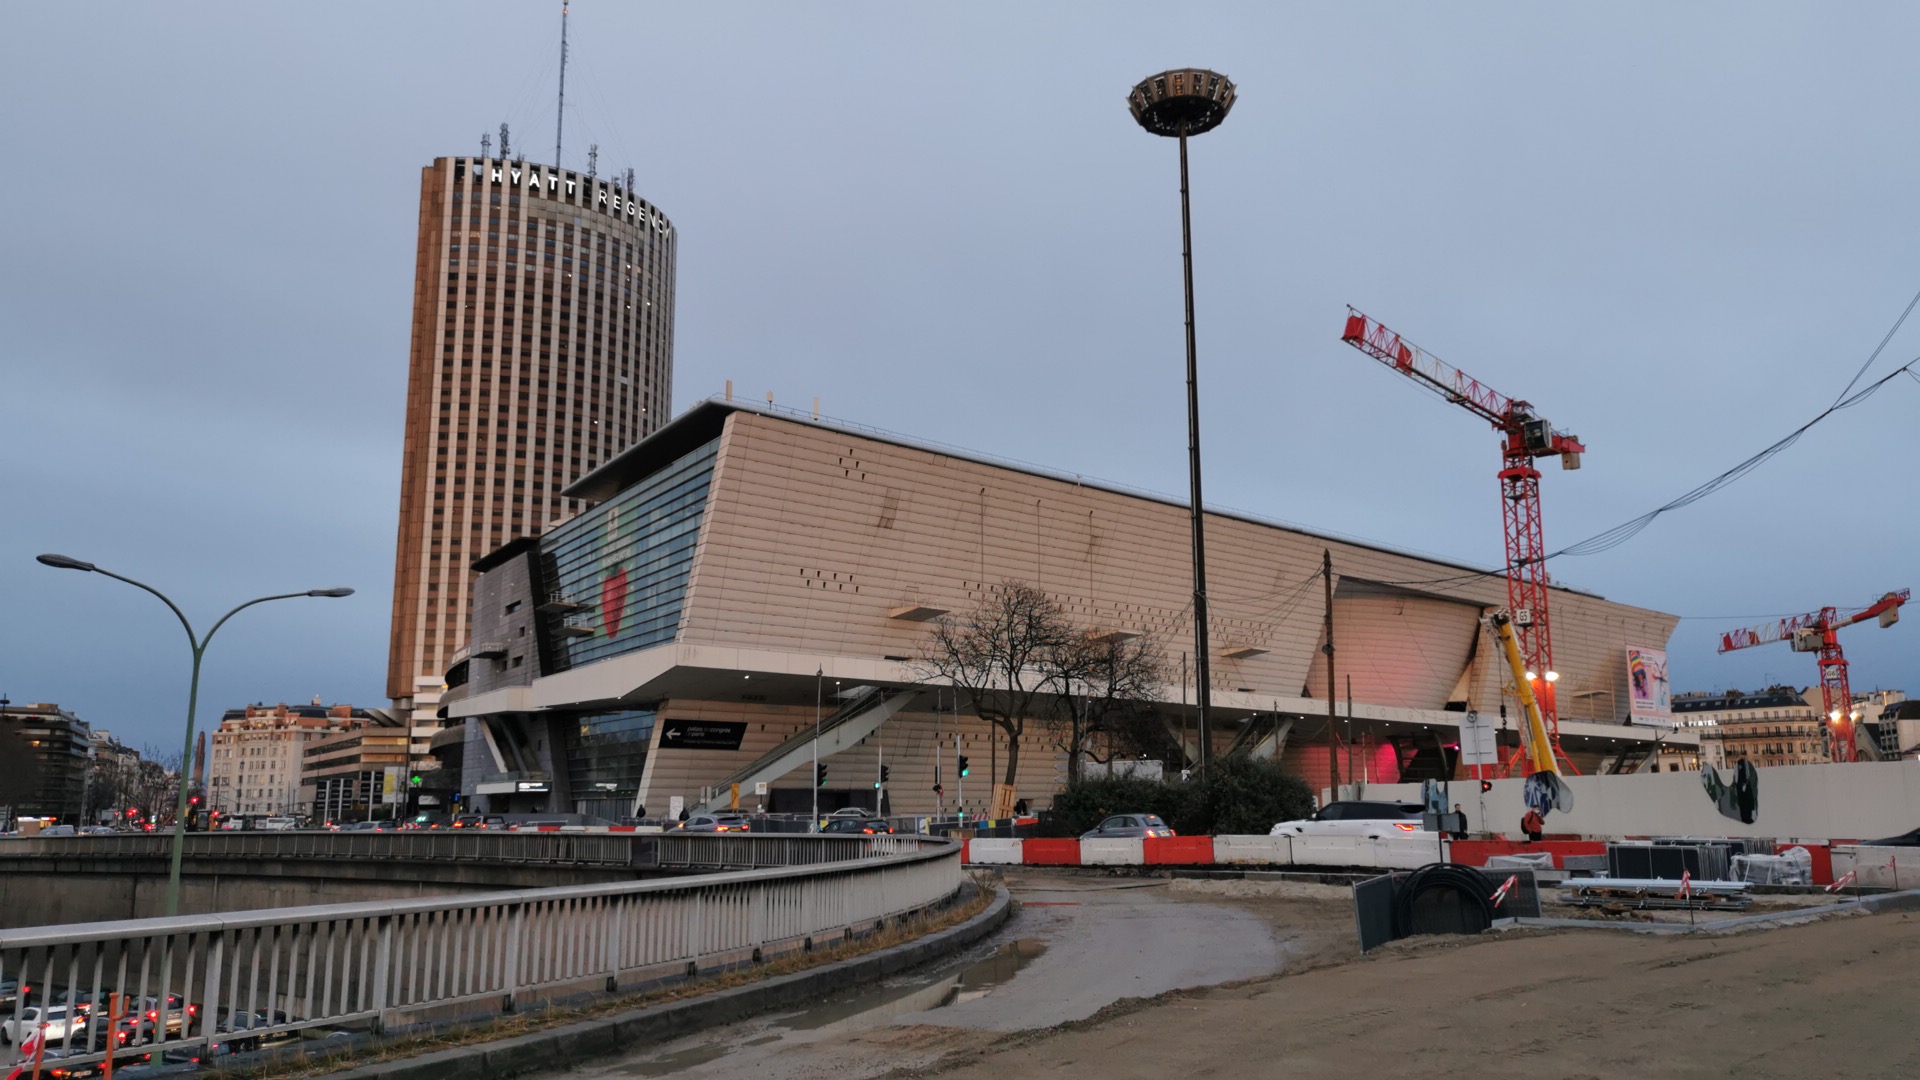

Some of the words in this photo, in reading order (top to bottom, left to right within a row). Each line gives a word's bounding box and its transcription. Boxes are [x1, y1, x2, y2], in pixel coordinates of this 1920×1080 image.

[492, 169, 576, 194] HYATT
[599, 190, 670, 236] REGENCY
[1519, 611, 1528, 621] G5
